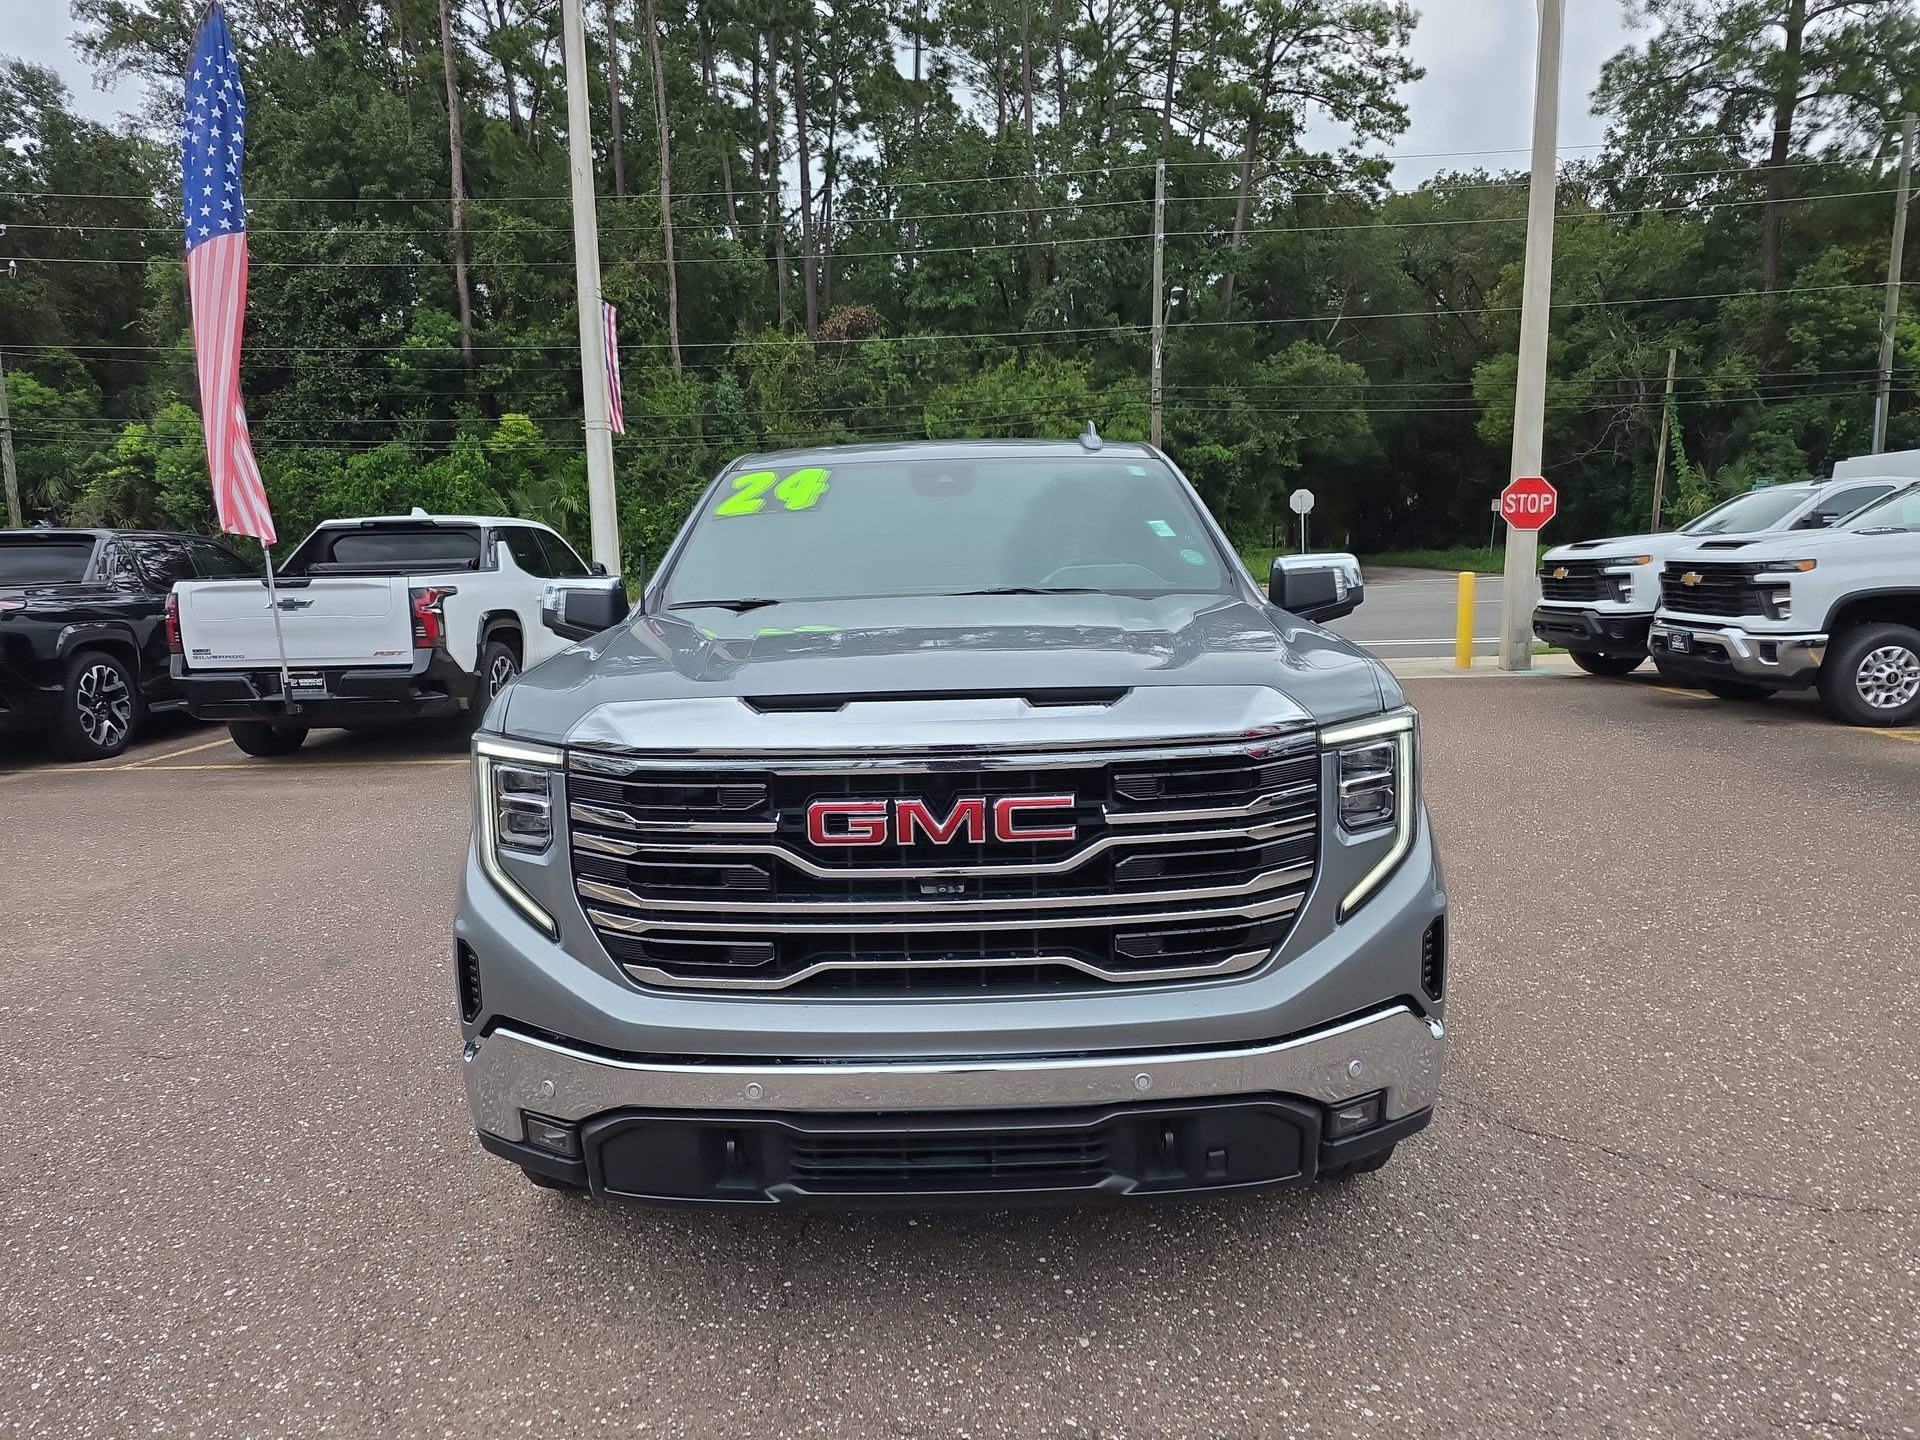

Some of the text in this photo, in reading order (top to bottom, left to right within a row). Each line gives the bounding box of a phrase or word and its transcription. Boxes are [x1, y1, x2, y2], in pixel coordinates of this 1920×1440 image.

[714, 467, 831, 516] 24
[1504, 493, 1553, 514] STOP
[807, 794, 1077, 847] GMC
